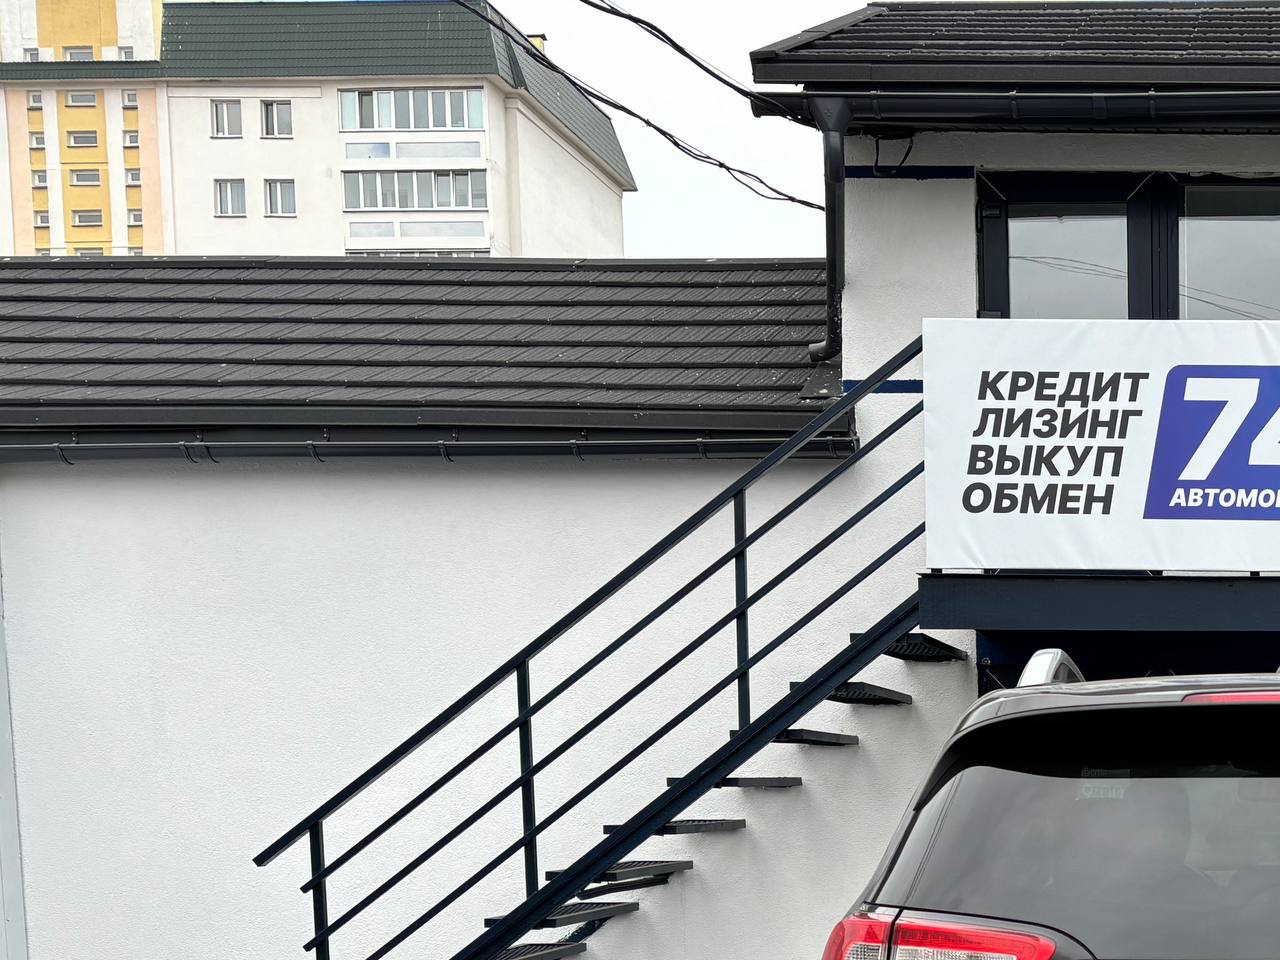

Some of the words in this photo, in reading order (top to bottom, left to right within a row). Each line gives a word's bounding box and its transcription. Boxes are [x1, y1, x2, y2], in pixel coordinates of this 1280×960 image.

[977, 370, 1150, 408] КРЕДИТ
[972, 408, 1143, 439] ЛИЗИНГ
[966, 444, 1124, 477] ВЫКУП
[962, 482, 1115, 515] ОБМЕН
